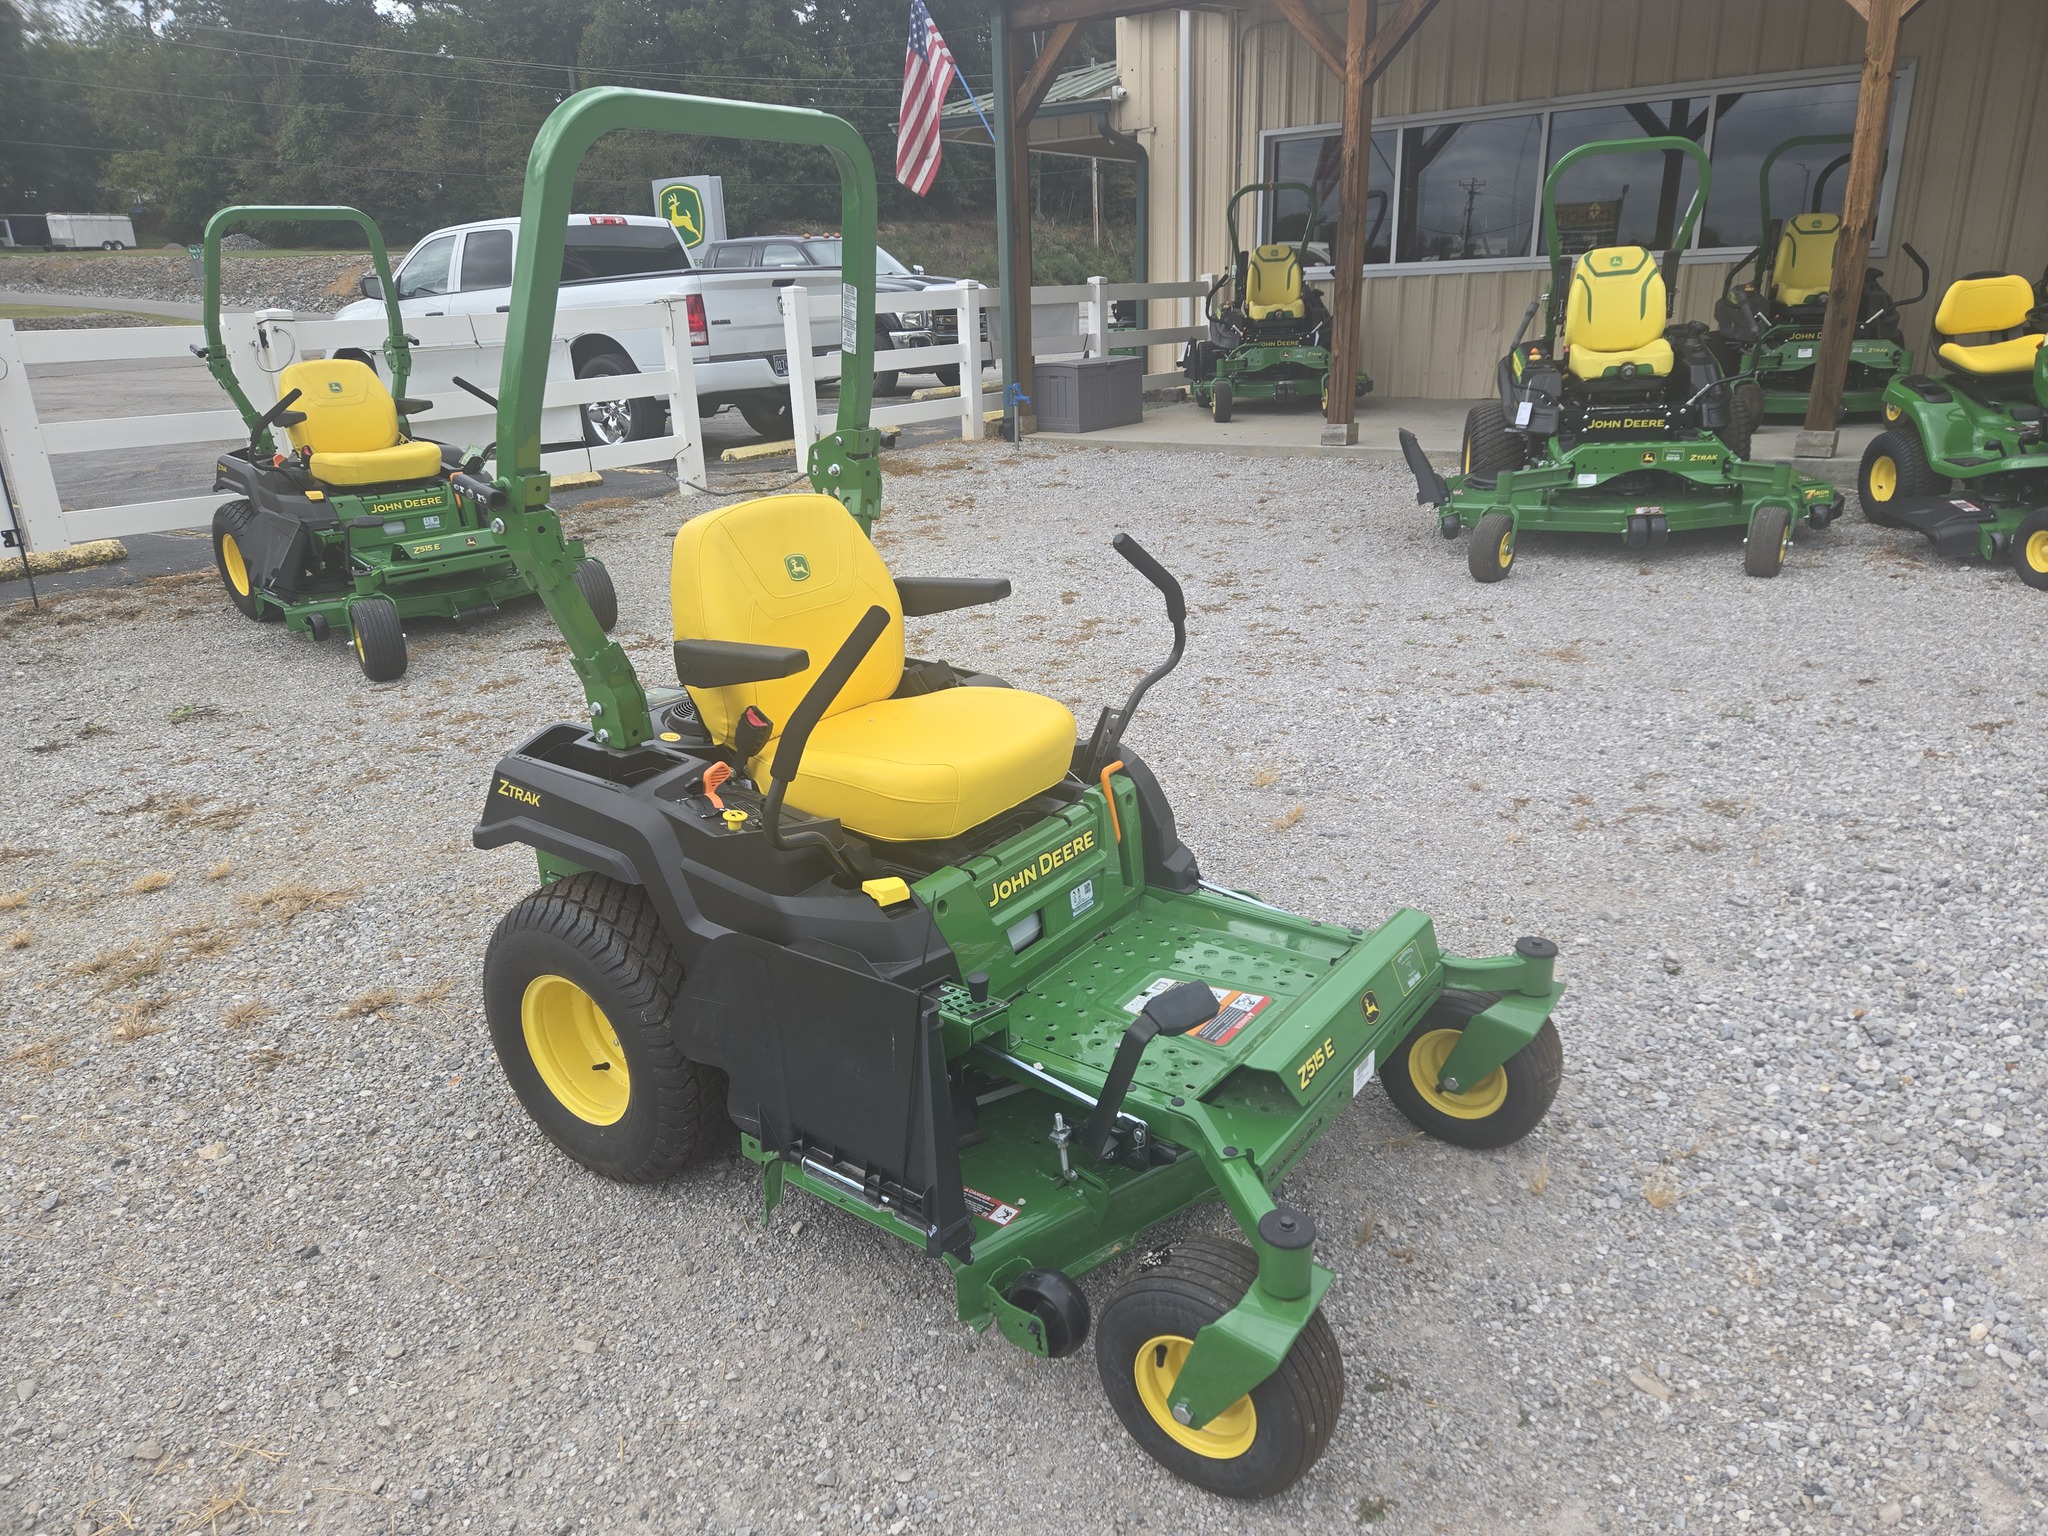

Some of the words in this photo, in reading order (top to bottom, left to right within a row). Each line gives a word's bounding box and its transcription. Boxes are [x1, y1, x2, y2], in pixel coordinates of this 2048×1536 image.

[1790, 332, 1816, 340] JOHN
[1587, 419, 1621, 429] JOHN
[1623, 418, 1665, 428] DEERE
[1688, 454, 1718, 462] ZTRAK
[371, 502, 402, 514] JOHN
[403, 496, 443, 509] DEERE
[413, 545, 433, 555] Z515
[498, 779, 542, 808] ZTRAK
[988, 864, 1038, 908] JOHN
[1038, 830, 1095, 877] DEERE
[1296, 1046, 1326, 1090] Z515
[1324, 1037, 1336, 1061] E
[968, 1188, 991, 1201] DANGER
